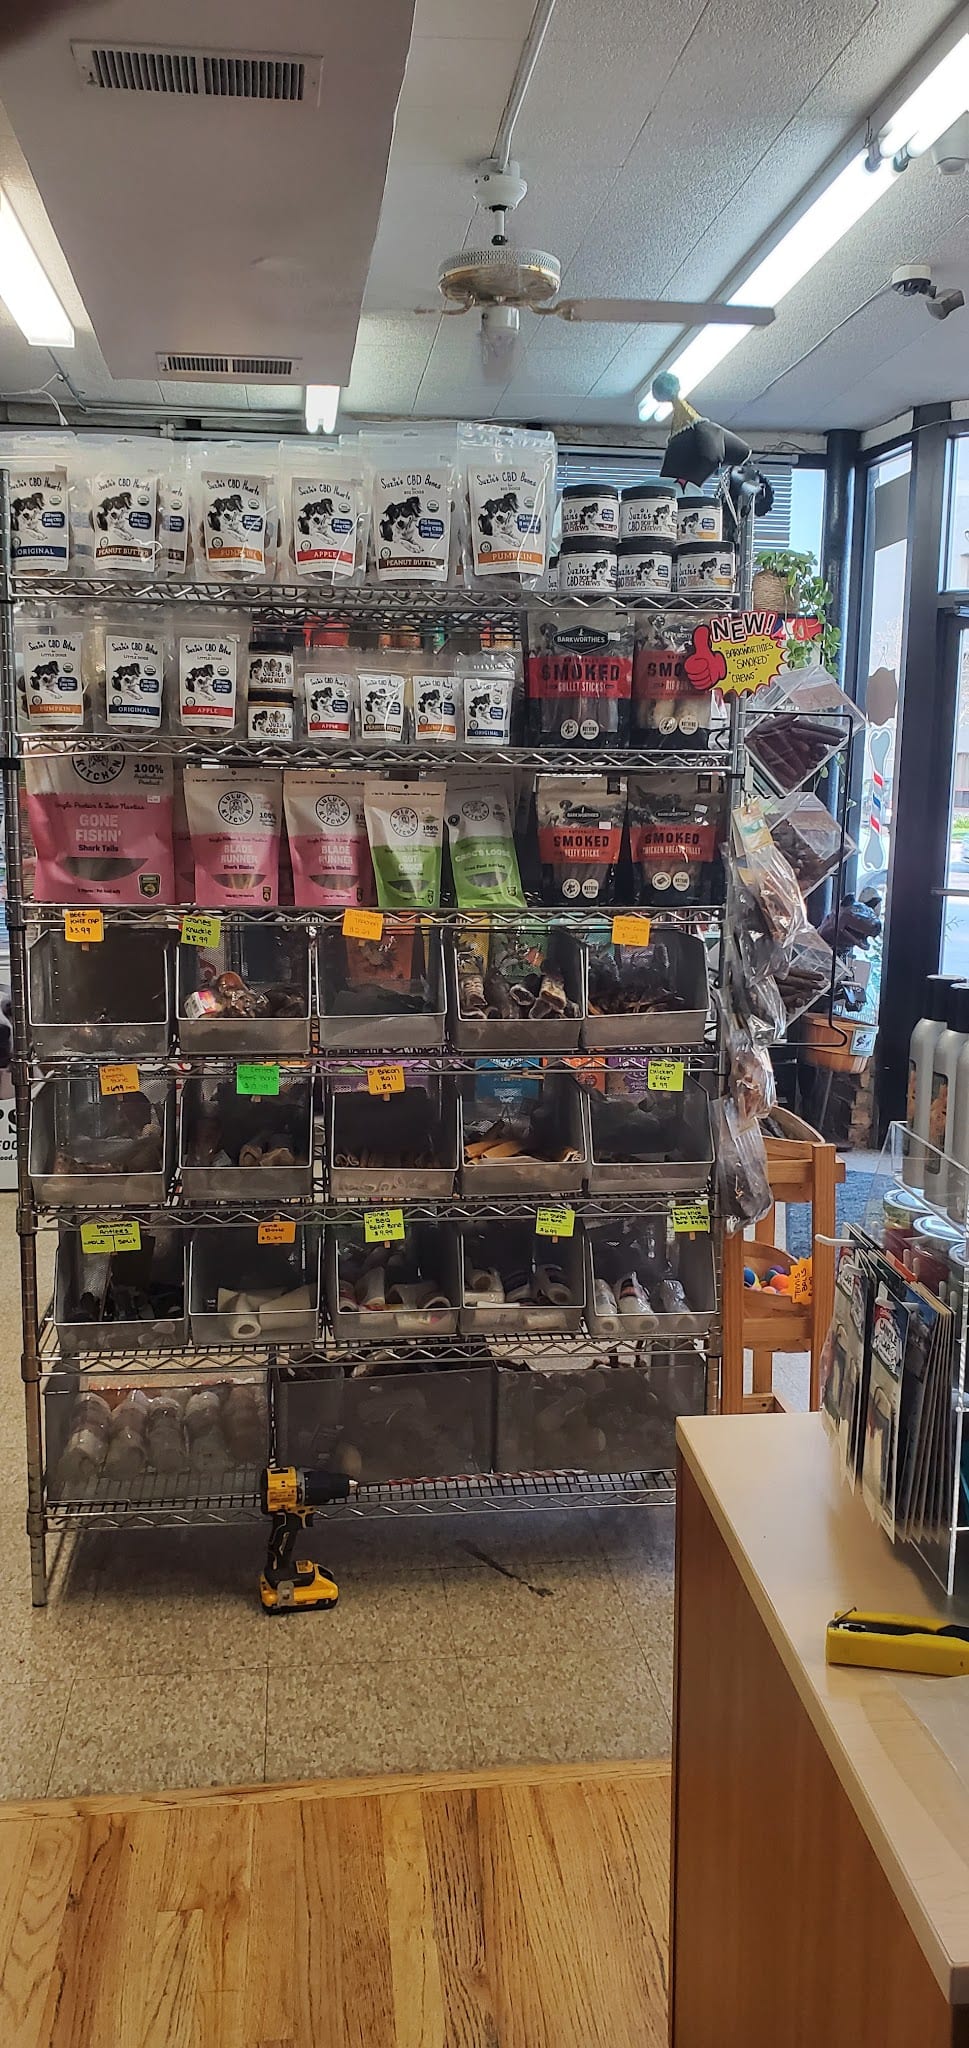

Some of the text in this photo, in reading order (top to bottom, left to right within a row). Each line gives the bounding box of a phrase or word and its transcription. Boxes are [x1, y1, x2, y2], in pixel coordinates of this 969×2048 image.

[29, 477, 42, 487] CBD
[118, 478, 131, 487] CBD
[227, 479, 240, 489] CBD
[380, 474, 441, 490] Suzie's CBD Bones
[477, 471, 537, 487] Suzie's CBD Bones
[319, 484, 332, 493] CBD
[628, 507, 652, 520] Suzie's
[627, 521, 640, 532] CBD
[98, 548, 149, 557] PEANUT BUTTER
[492, 553, 533, 561] PUMPKIN
[567, 562, 590, 576] Suzie's
[566, 576, 578, 587] CBD
[711, 612, 776, 643] NEW!
[48, 640, 60, 648] CBD
[131, 642, 143, 651] CBD
[204, 643, 217, 652] CBD
[725, 642, 774, 659] BARKWORTHIES
[541, 663, 620, 681] SMOKED
[731, 671, 755, 683] CHEWS
[260, 676, 274, 684] GOES
[558, 682, 580, 692] GULLET
[118, 706, 151, 714] ORIGINAL
[75, 759, 122, 781] KITCHEN
[134, 763, 164, 774] 100%
[222, 793, 249, 805] LULU'S
[79, 814, 119, 827] GONE
[221, 809, 252, 823] KITCHEN
[318, 810, 348, 824] KITCHEN
[75, 829, 122, 842] FISHN'
[553, 835, 609, 847] SMOKED
[644, 832, 700, 844] SMOKED
[78, 844, 101, 852] Shark
[224, 844, 253, 854] BLADE
[321, 845, 351, 854] BLADE
[221, 854, 257, 864] RUNNER
